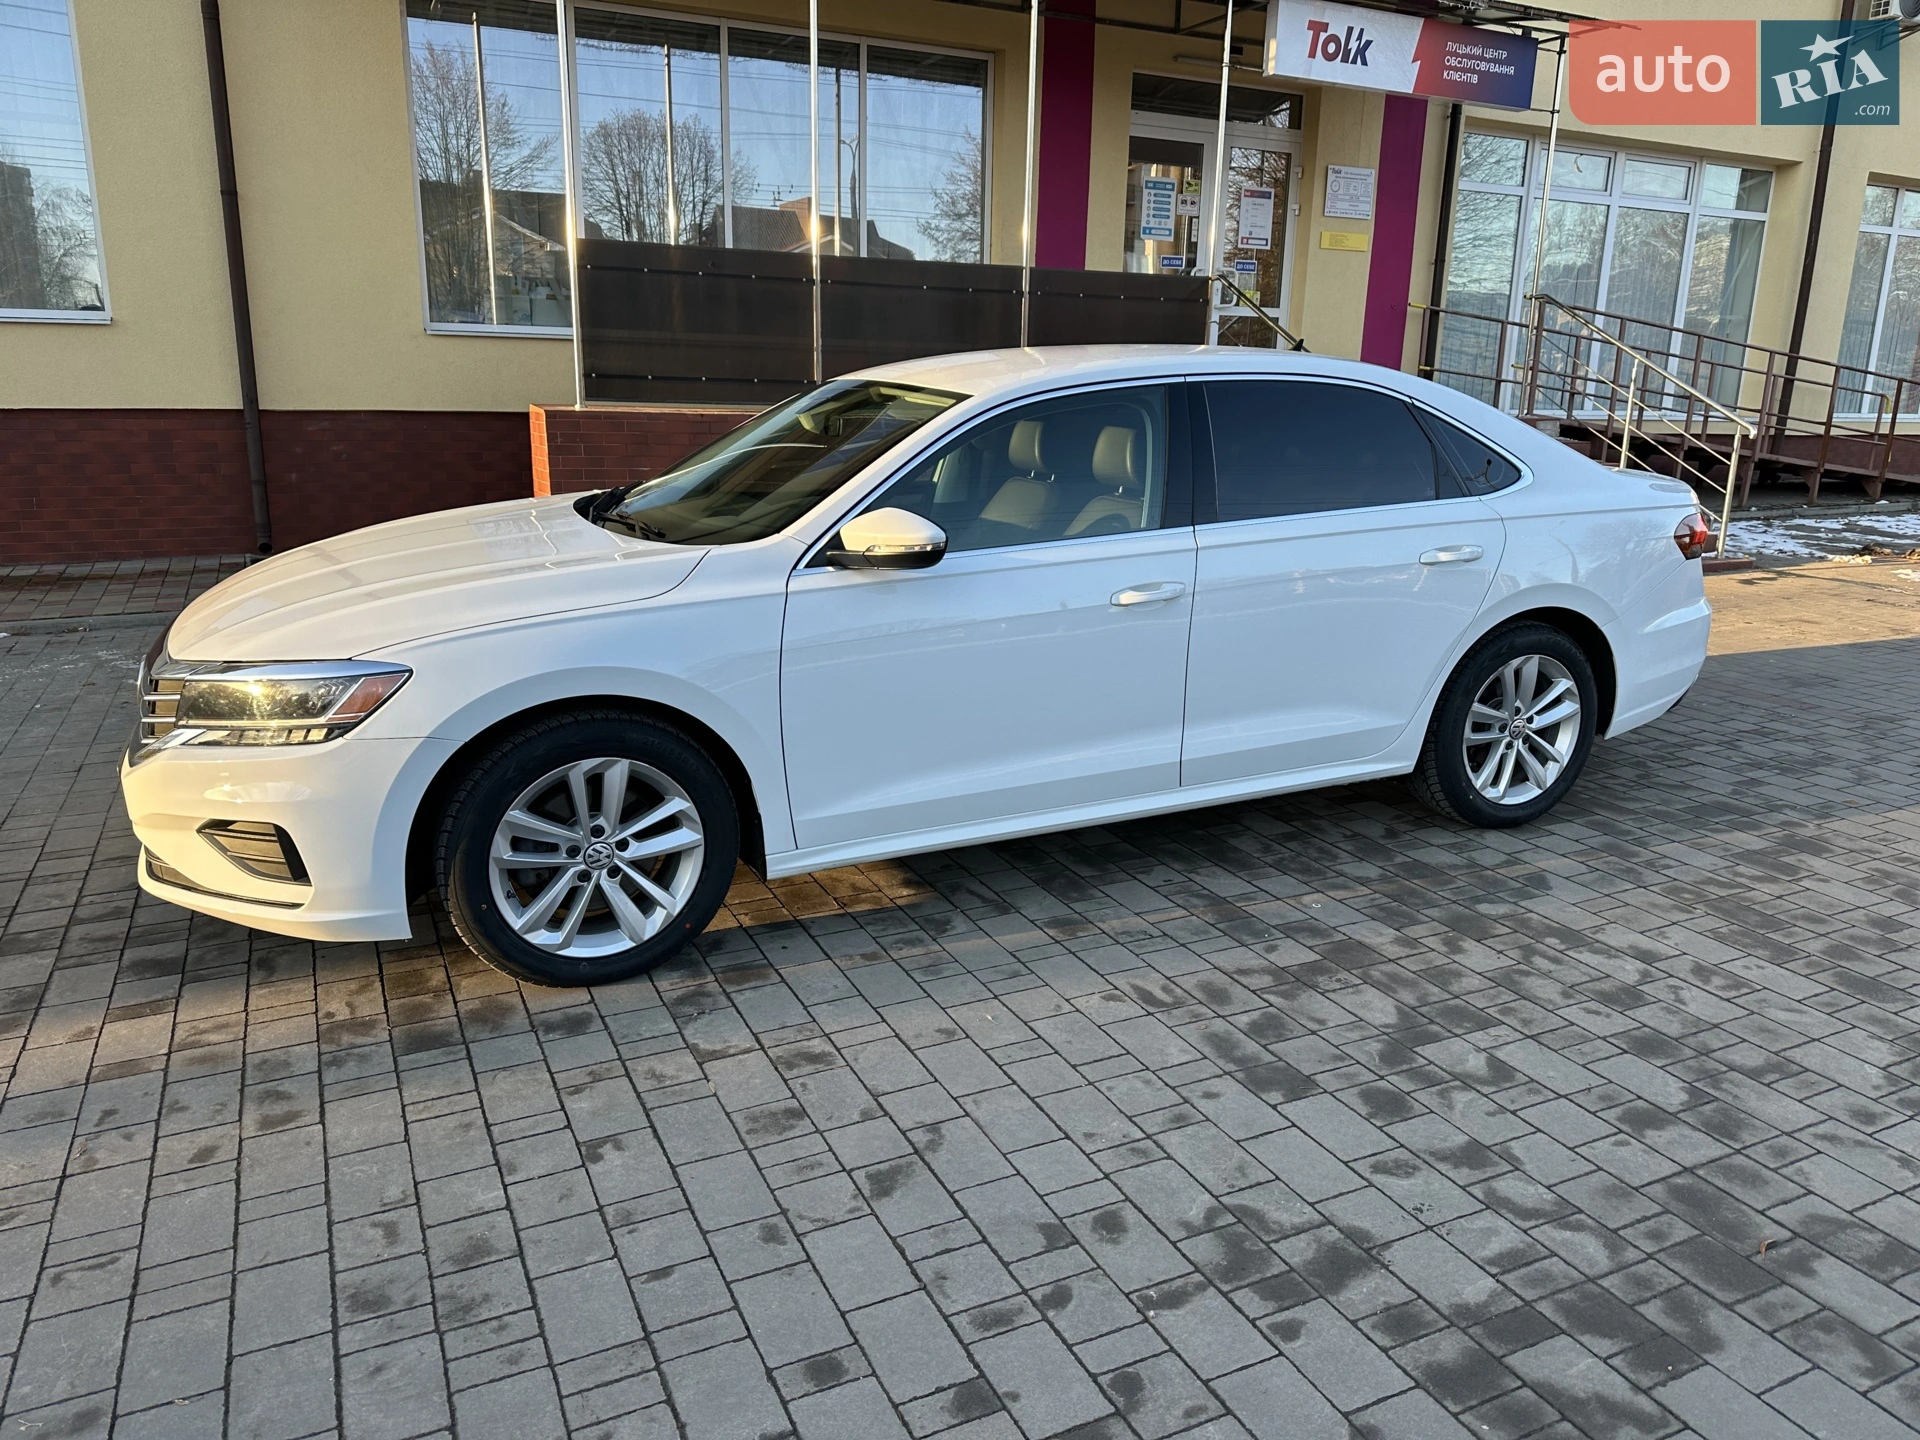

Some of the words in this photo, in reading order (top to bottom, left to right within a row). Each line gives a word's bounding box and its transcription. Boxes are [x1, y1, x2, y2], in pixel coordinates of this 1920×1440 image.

[1306, 19, 1374, 67] Tolk
[1445, 41, 1483, 57] ЛУЦЬКИЙ
[1483, 47, 1508, 60] ЦЕНТР
[1444, 55, 1515, 76] ОБСЛУГОВУВАННЯ
[1443, 69, 1479, 84] КЛІЄНТІВ
